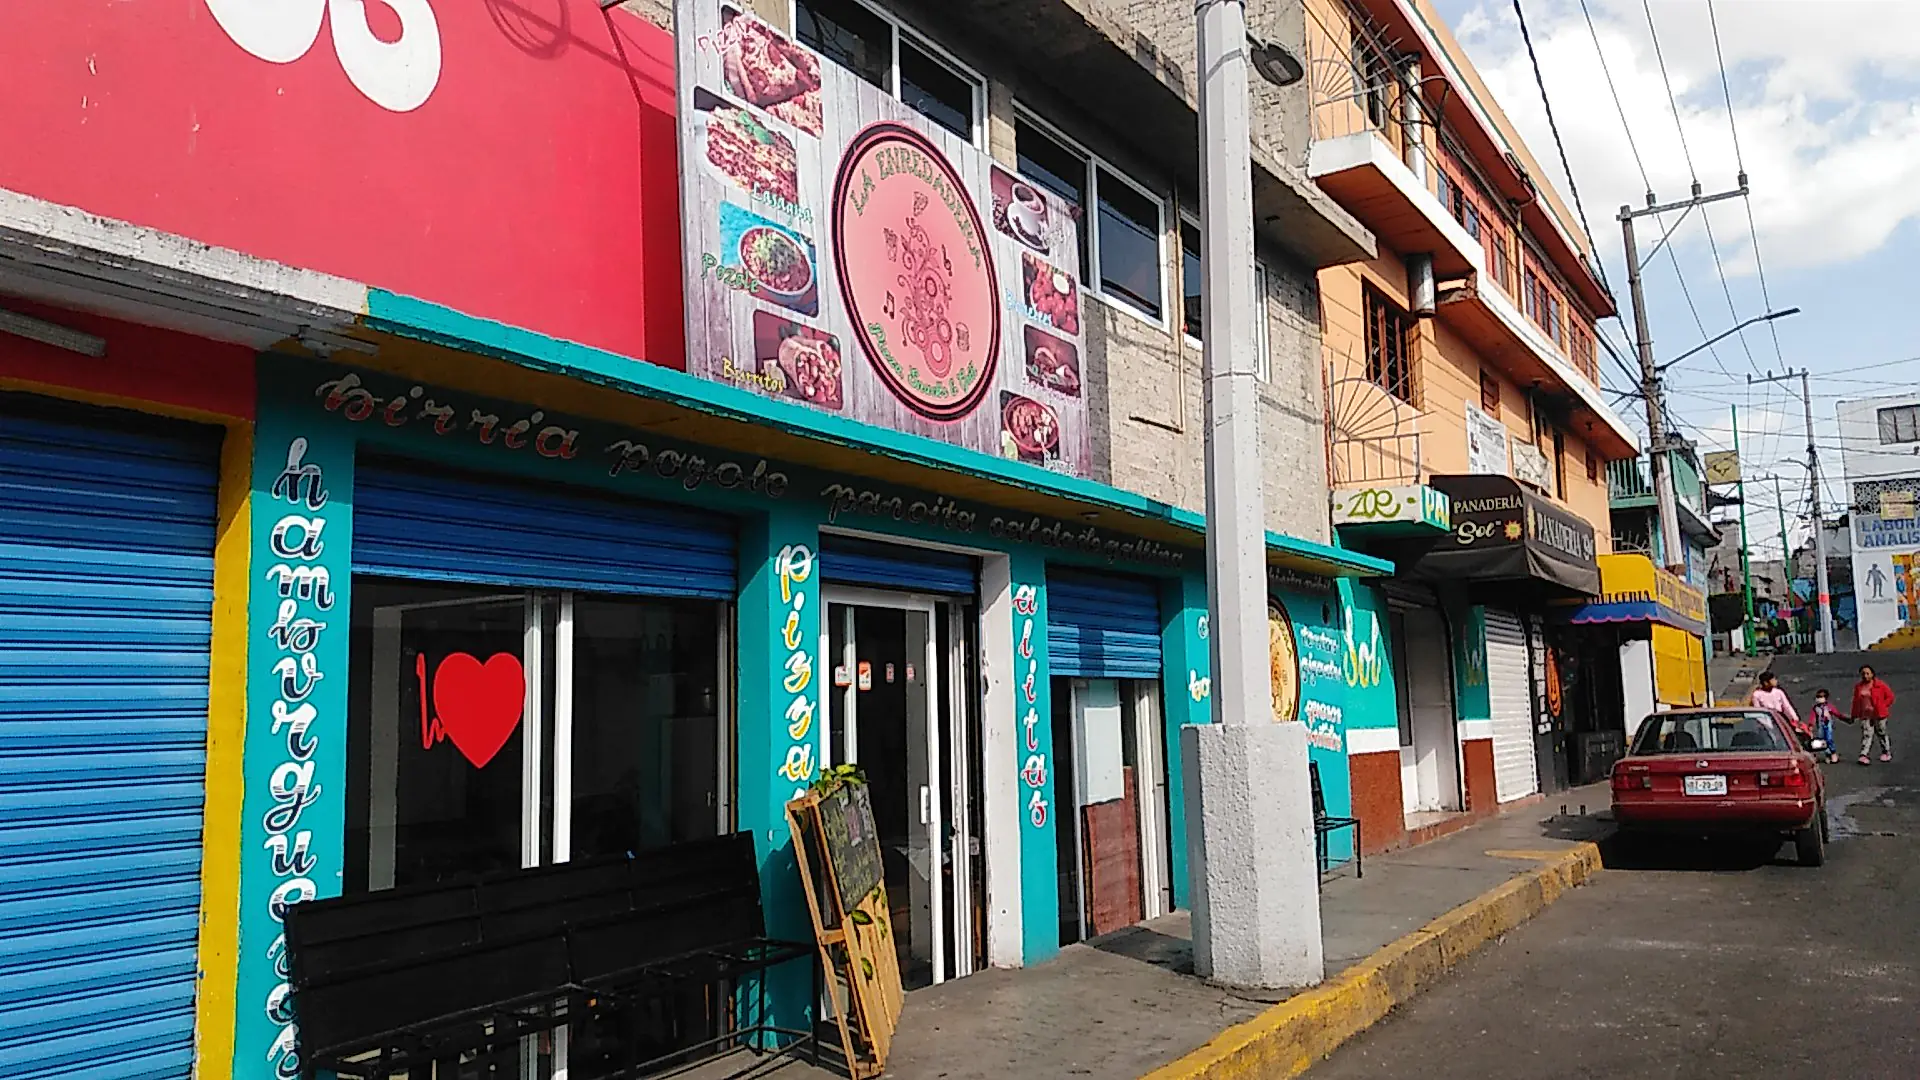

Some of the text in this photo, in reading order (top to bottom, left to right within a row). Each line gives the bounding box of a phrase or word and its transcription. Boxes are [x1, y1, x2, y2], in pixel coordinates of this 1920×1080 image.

[849, 167, 877, 217] LA
[700, 251, 761, 294] Pozole
[315, 372, 581, 462] birria
[604, 434, 790, 500] pozole
[1012, 584, 1048, 828] alitas
